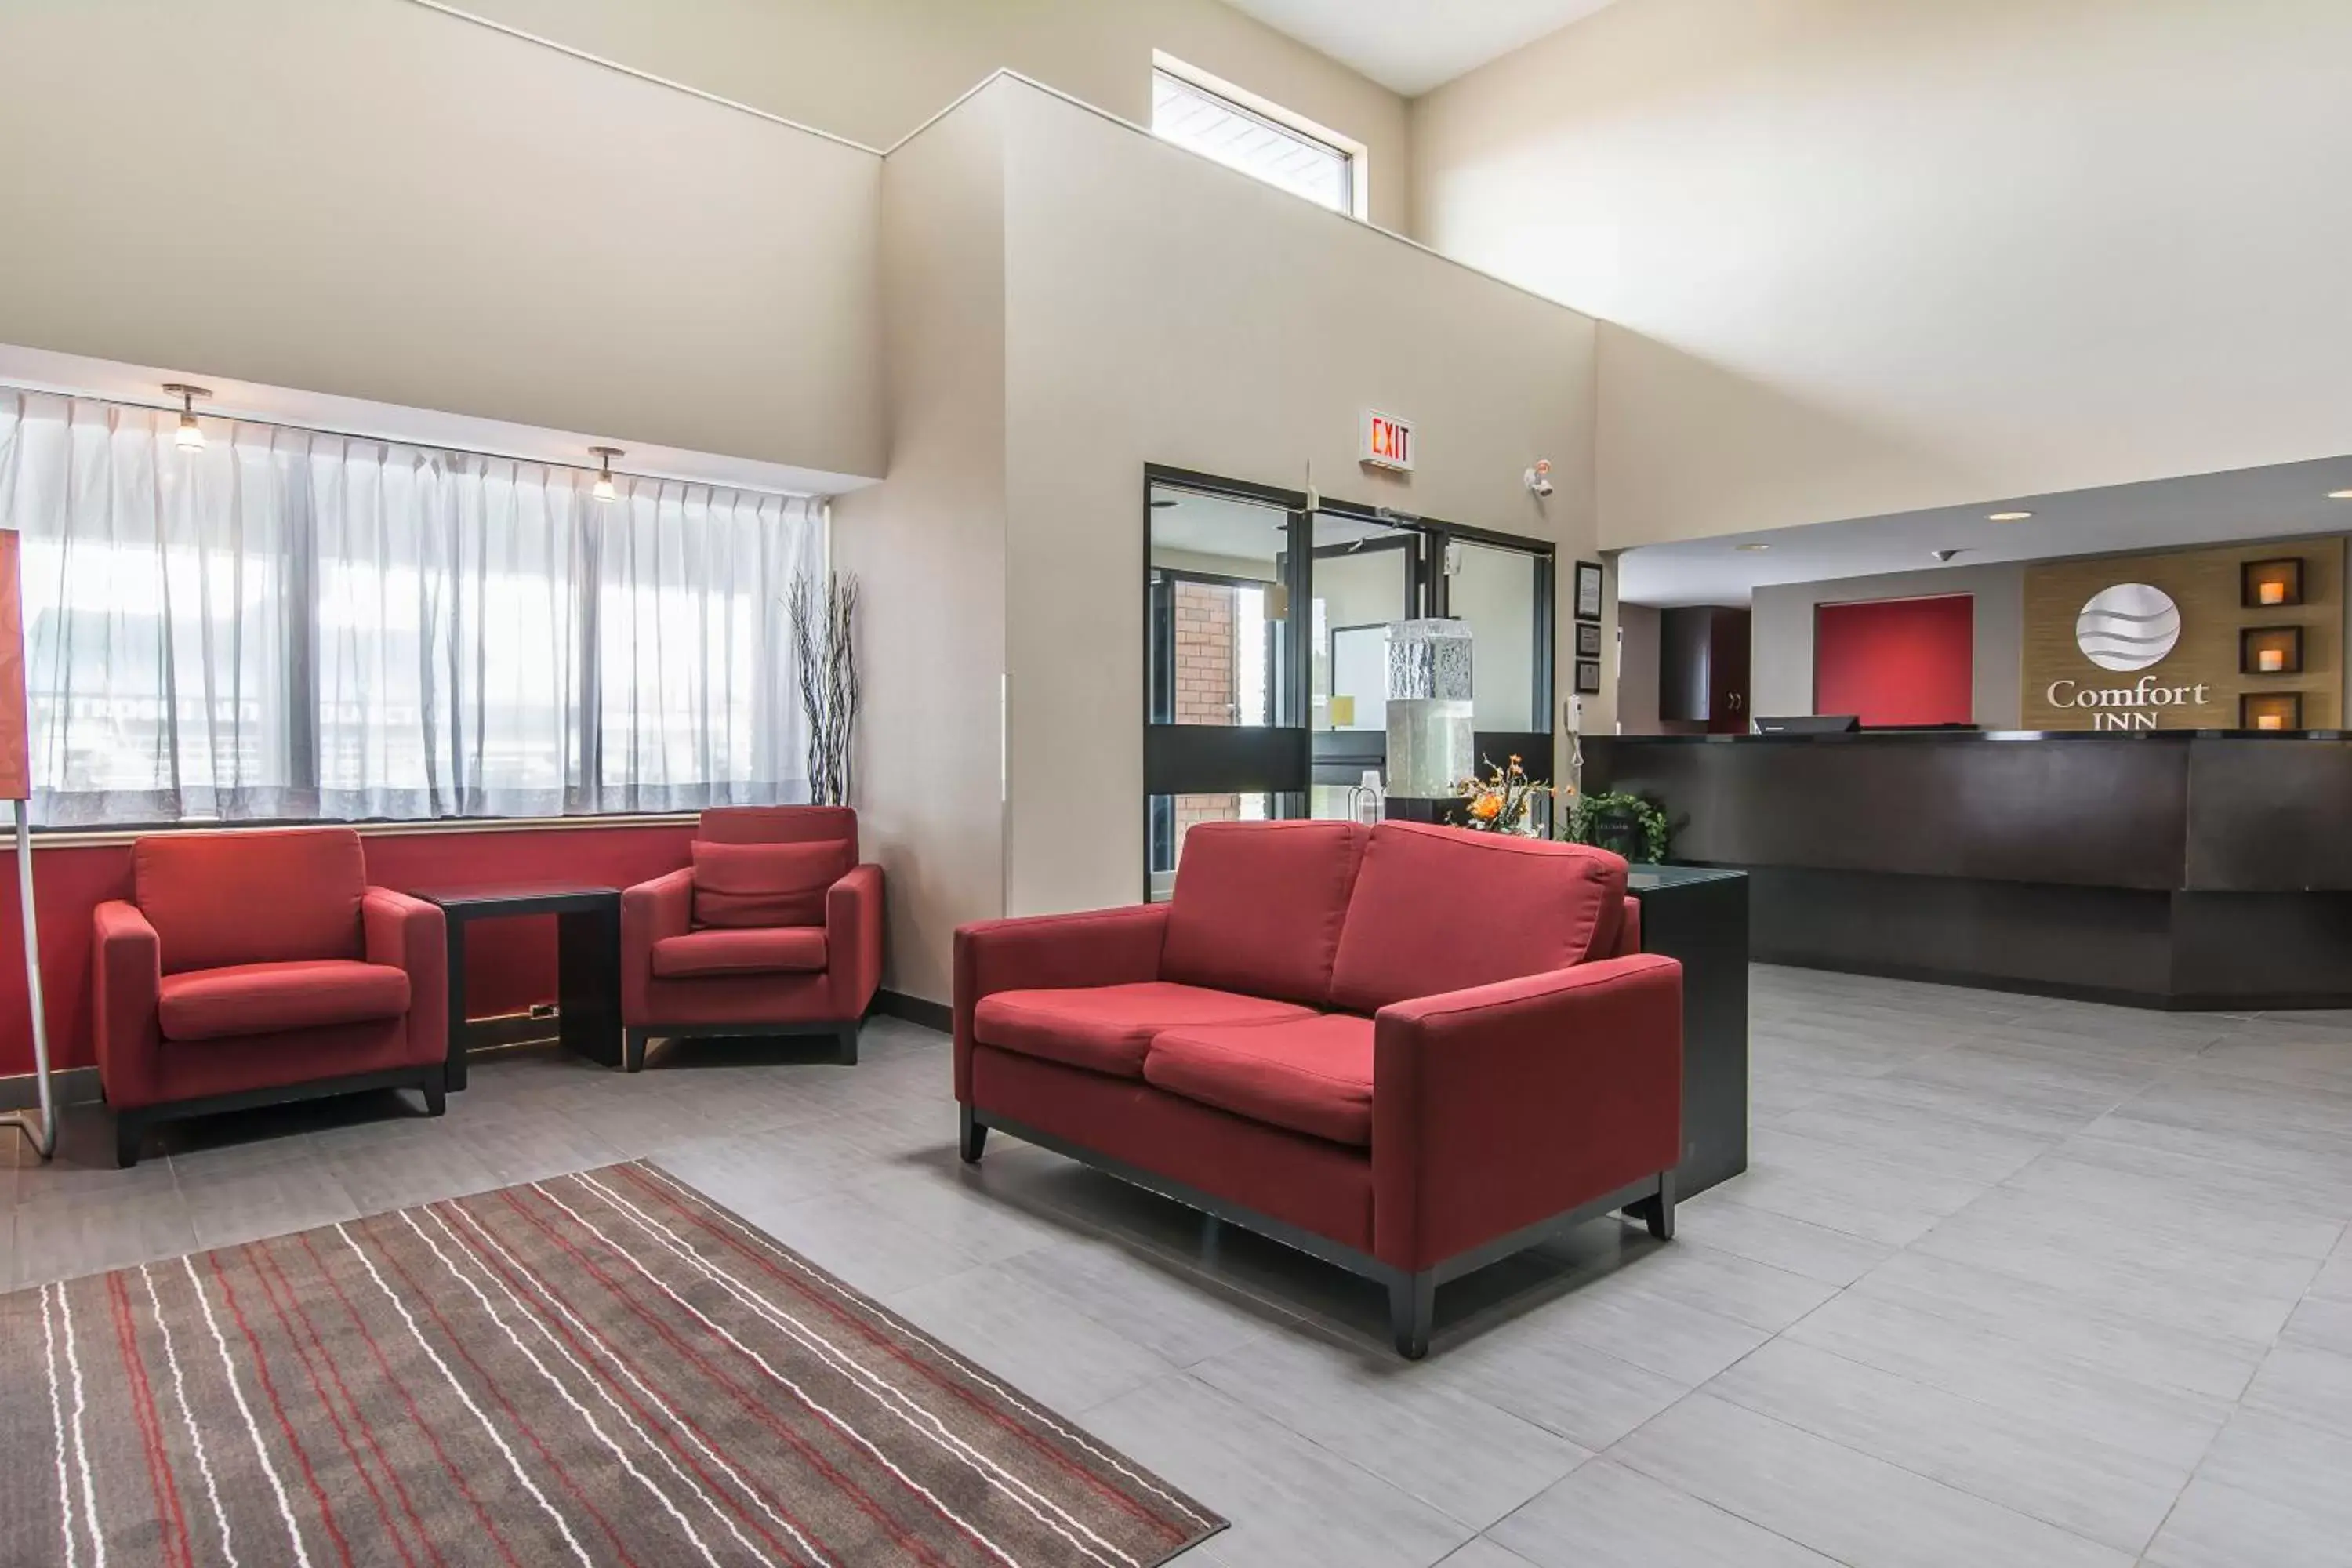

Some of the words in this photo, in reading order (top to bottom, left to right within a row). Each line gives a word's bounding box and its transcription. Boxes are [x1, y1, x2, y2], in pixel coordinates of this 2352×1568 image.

[1373, 418, 1409, 461] EXIT
[2047, 675, 2210, 708] Comfort
[2092, 711, 2158, 731] INN
